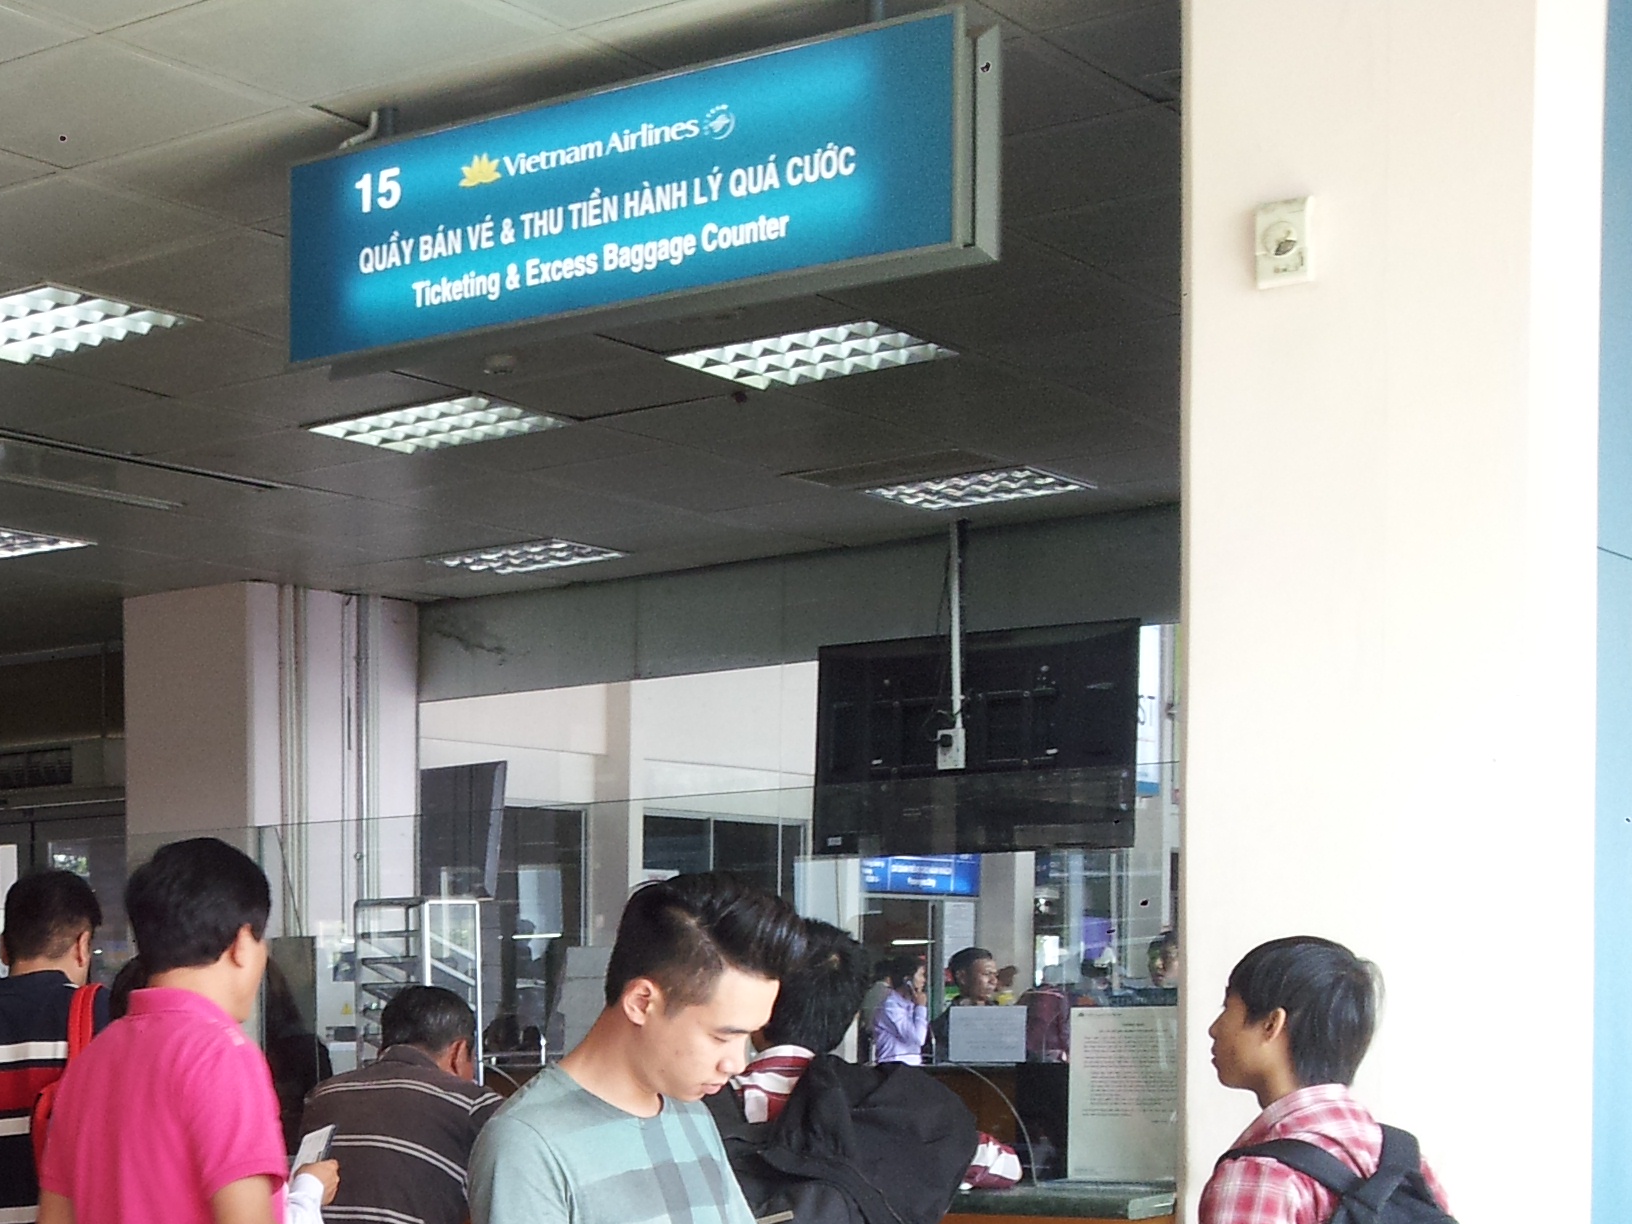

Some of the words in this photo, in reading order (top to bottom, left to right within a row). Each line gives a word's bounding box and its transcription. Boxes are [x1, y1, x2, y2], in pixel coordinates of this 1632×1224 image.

[503, 140, 603, 177] Vietnam
[605, 119, 700, 154] Airlines
[355, 167, 401, 213] 15
[359, 230, 415, 274] QUẦY
[418, 224, 462, 262] BÁN
[466, 214, 496, 251] VÉ
[500, 218, 515, 245] &
[520, 206, 564, 240] THU
[568, 187, 618, 230] TIỀN
[624, 181, 687, 219] HÀNH
[693, 166, 723, 205] LÝ
[729, 154, 781, 197] QUÁ
[786, 142, 857, 186] CƯỚC
[412, 270, 500, 308] Ticketing
[505, 263, 520, 290] &
[525, 252, 598, 287] Excess
[603, 233, 697, 273] Baggage
[701, 215, 789, 252] Counter
